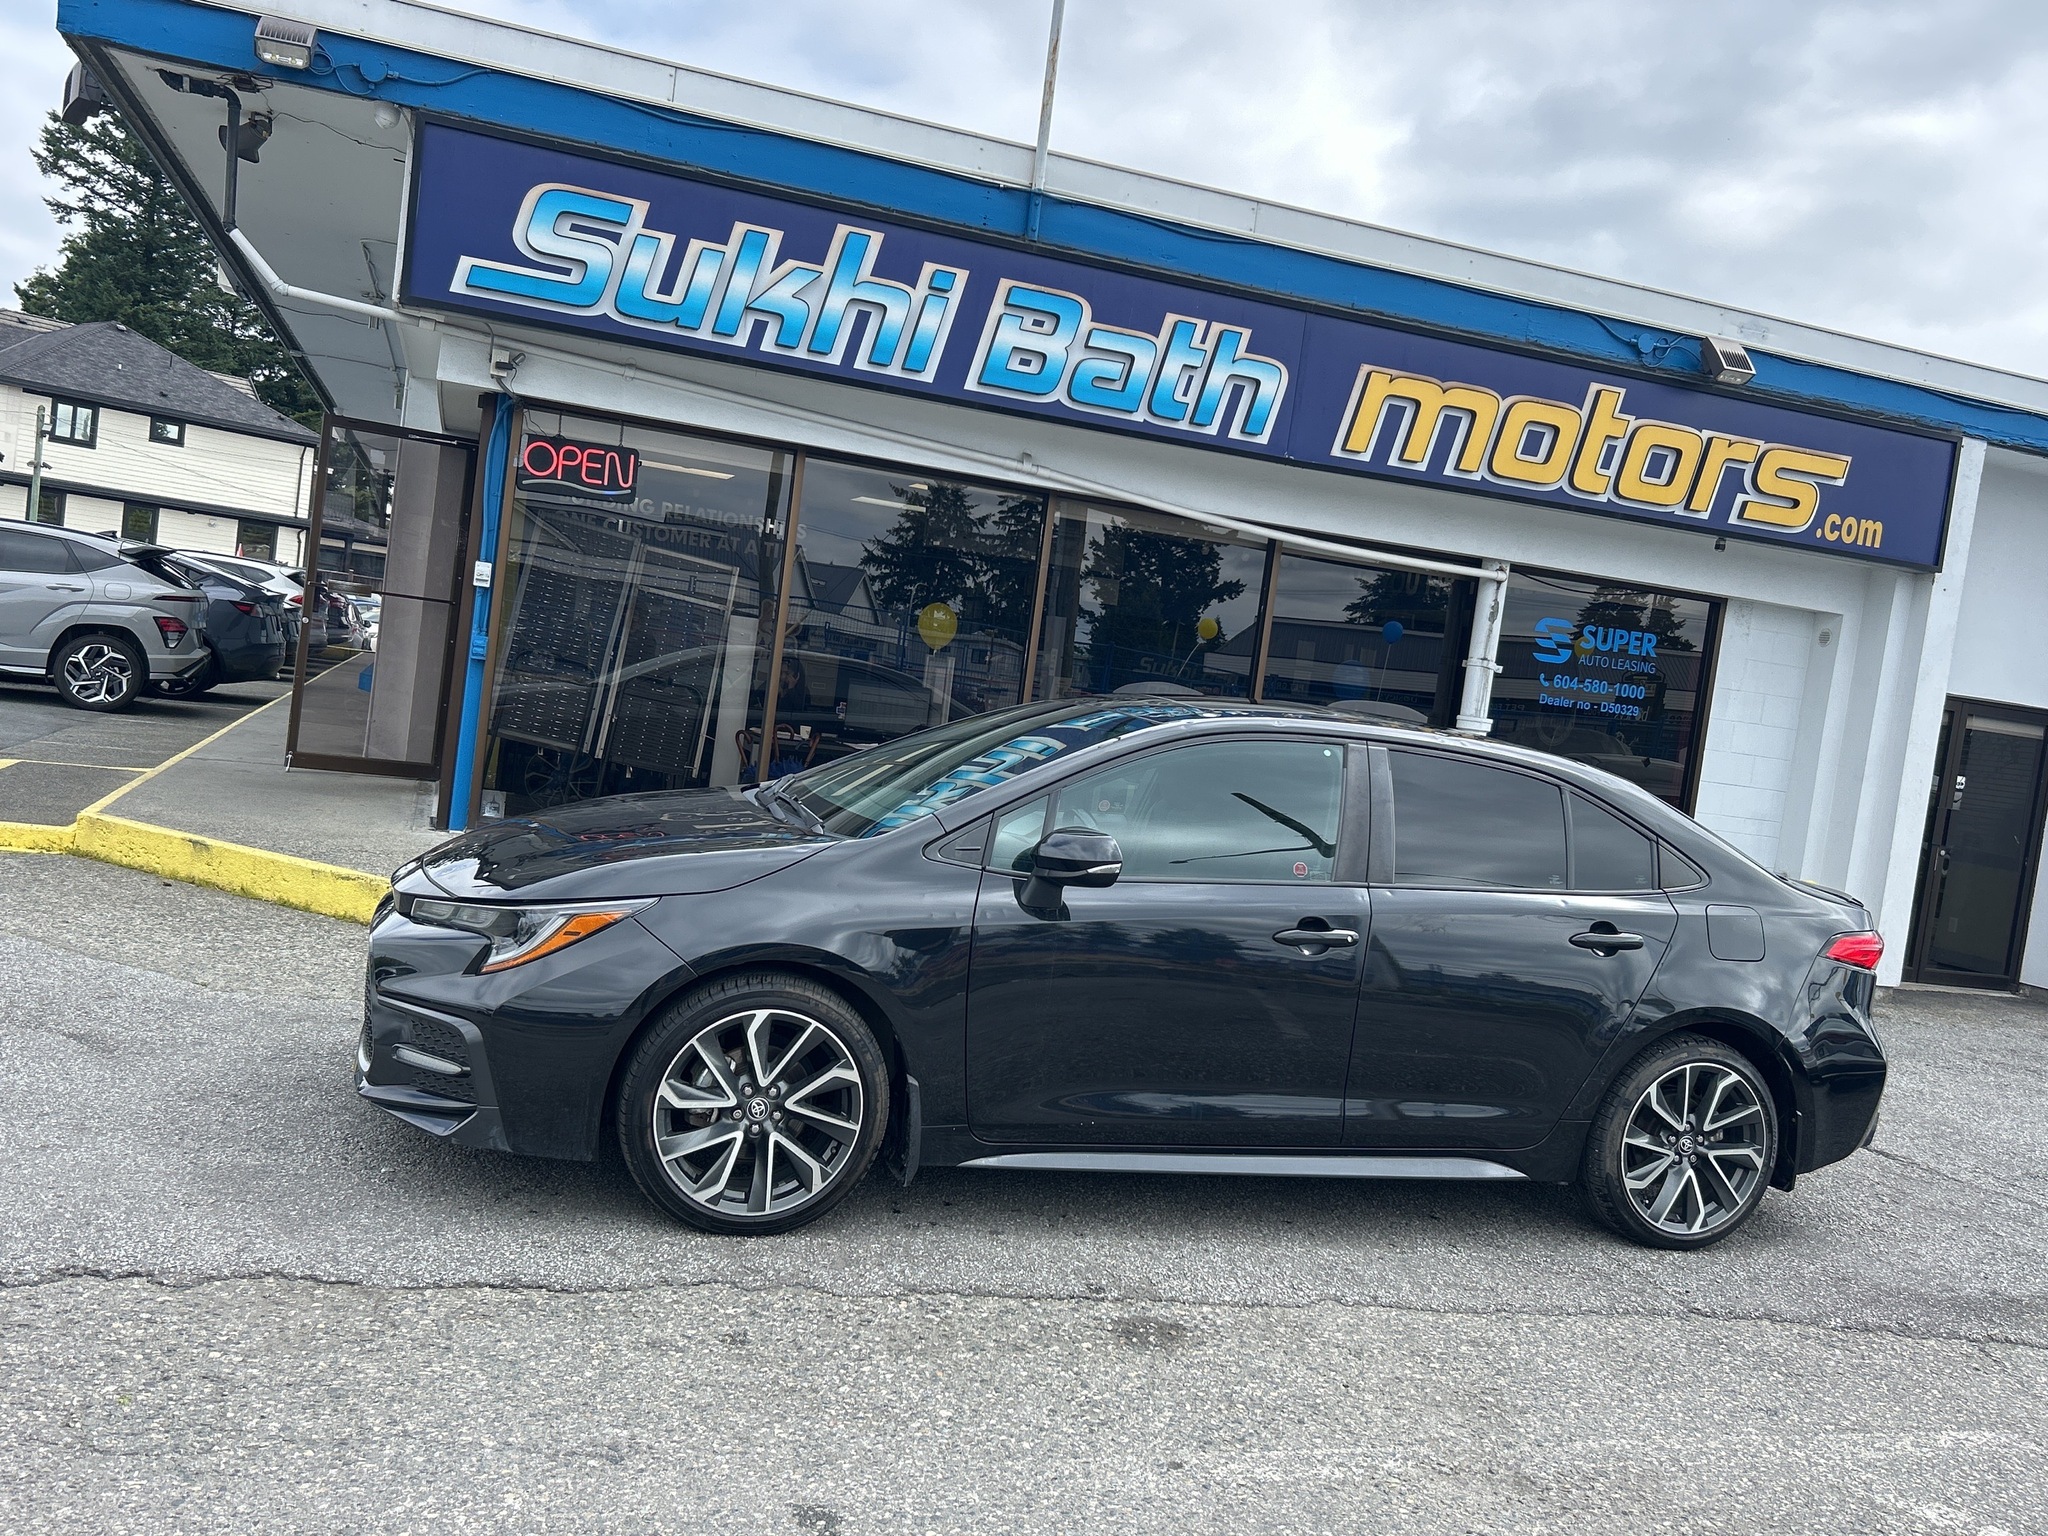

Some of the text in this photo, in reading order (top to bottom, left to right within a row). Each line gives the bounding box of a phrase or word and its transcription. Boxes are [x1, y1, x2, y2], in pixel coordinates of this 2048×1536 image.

[449, 183, 1882, 548] Sukhi Bath motors .com
[523, 441, 635, 488] OPEN
[604, 517, 711, 549] CUSTOMER
[716, 536, 741, 552] AT
[744, 539, 759, 556] A
[660, 501, 807, 540] RELATIONSHIS
[1580, 625, 1657, 658] SUPER
[1578, 654, 1656, 674] AUTO LEASING
[1553, 674, 1645, 699] 604-580-1000
[1539, 693, 1574, 708] Dealer
[1577, 700, 1591, 710] no
[1600, 701, 1639, 717] D50329
